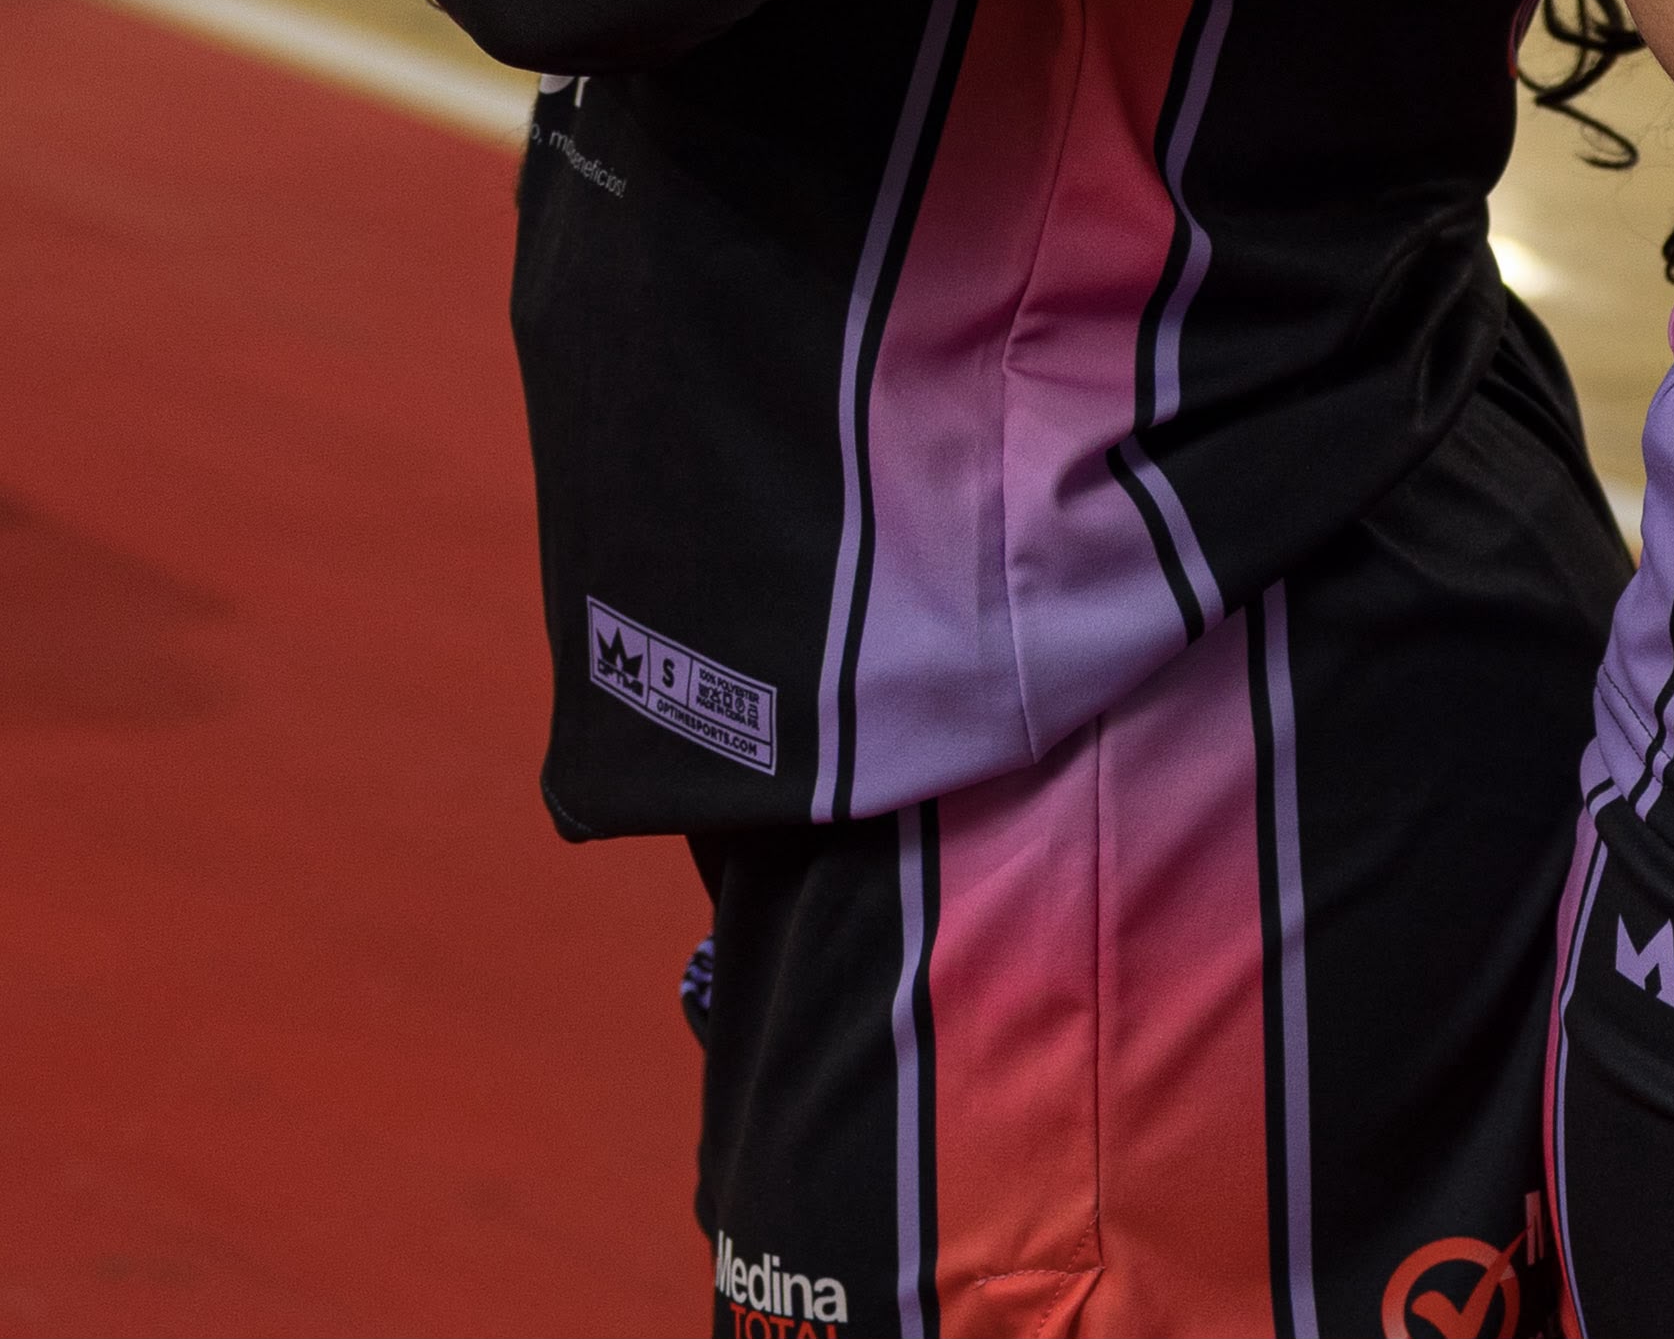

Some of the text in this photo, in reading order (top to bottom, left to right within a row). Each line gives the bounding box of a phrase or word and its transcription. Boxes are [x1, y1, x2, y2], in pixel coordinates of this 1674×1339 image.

[662, 657, 675, 689] S
[656, 699, 758, 757] OPTIMESPORTS.COM
[716, 1229, 848, 1323] Medina
